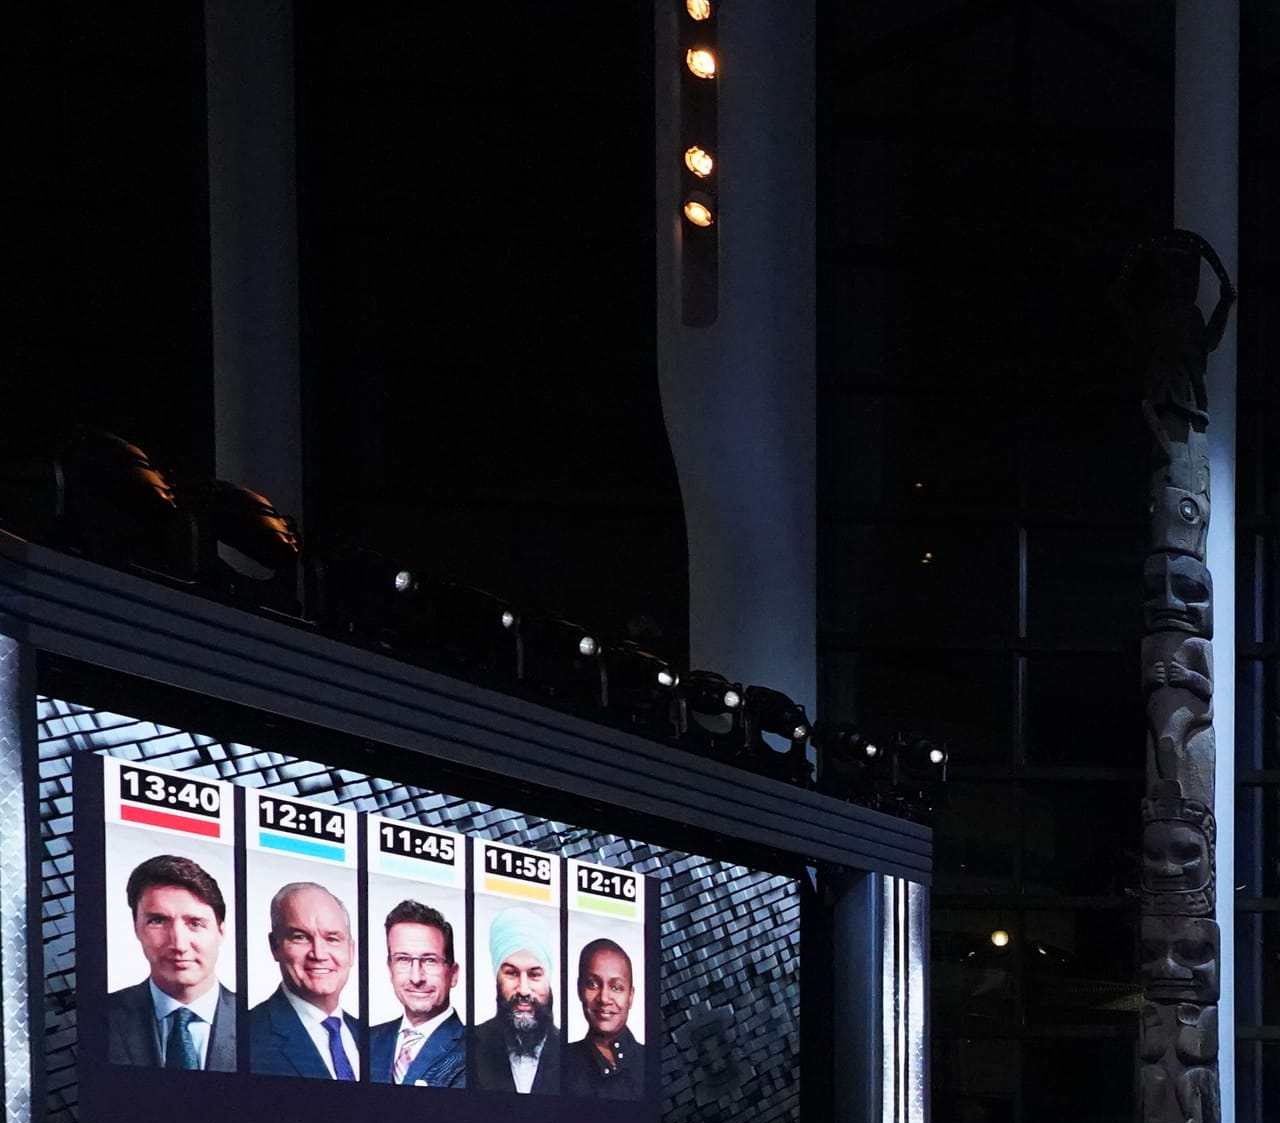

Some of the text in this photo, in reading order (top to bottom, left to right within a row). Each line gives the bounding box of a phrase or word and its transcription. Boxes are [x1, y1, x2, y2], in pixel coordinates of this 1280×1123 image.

[123, 771, 220, 812] 13:40
[260, 800, 345, 838] 12:14
[381, 826, 455, 861] 11:45
[486, 849, 552, 881] 11:58
[578, 868, 636, 899] 12:16
